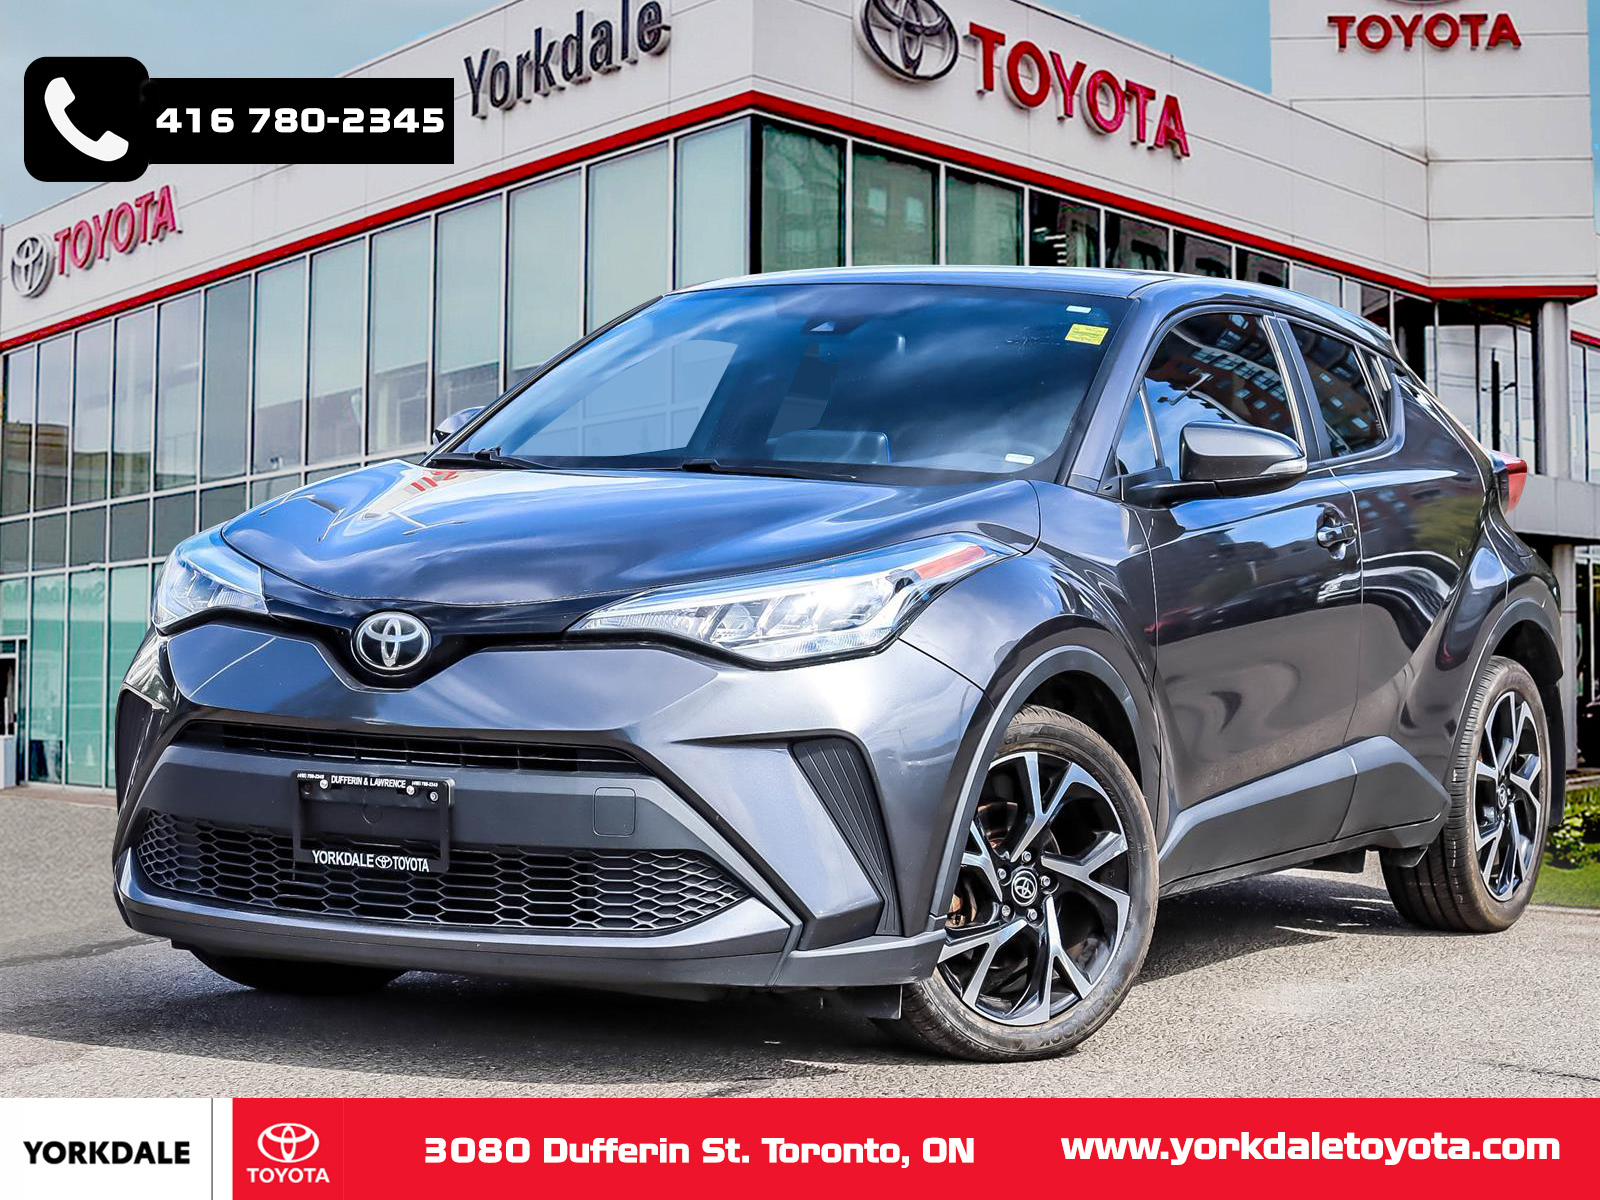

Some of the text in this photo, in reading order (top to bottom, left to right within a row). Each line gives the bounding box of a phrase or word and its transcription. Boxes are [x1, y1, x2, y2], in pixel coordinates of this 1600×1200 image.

[464, 0, 672, 119] Yorkdale
[1327, 13, 1522, 51] TOYOTA
[967, 21, 1190, 159] TOYOTA
[54, 185, 181, 277] TOYOTA
[330, 774, 363, 786] DUFFERIN
[369, 778, 406, 789] LAWRENCE
[311, 850, 430, 873] YORKDALE TOYOTA
